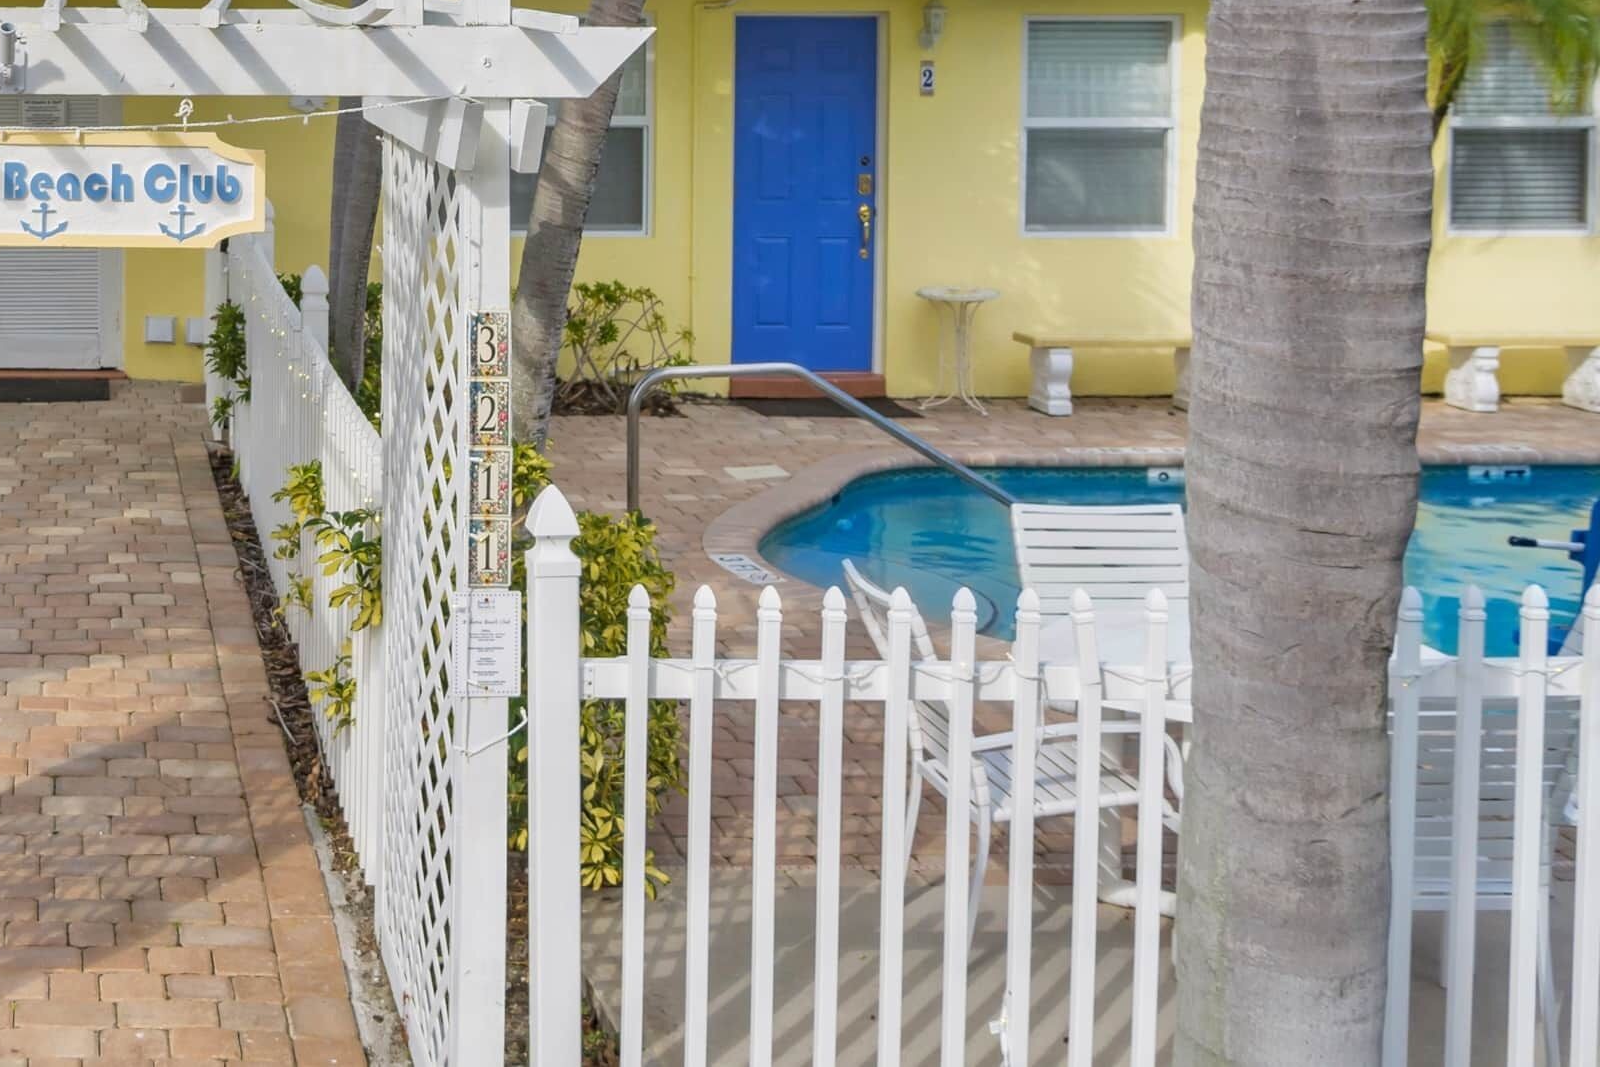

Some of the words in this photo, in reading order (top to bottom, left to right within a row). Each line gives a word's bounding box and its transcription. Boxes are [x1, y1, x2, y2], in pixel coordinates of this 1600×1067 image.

[922, 69, 933, 87] 2
[3, 161, 135, 203] Beach
[143, 163, 243, 204] Club
